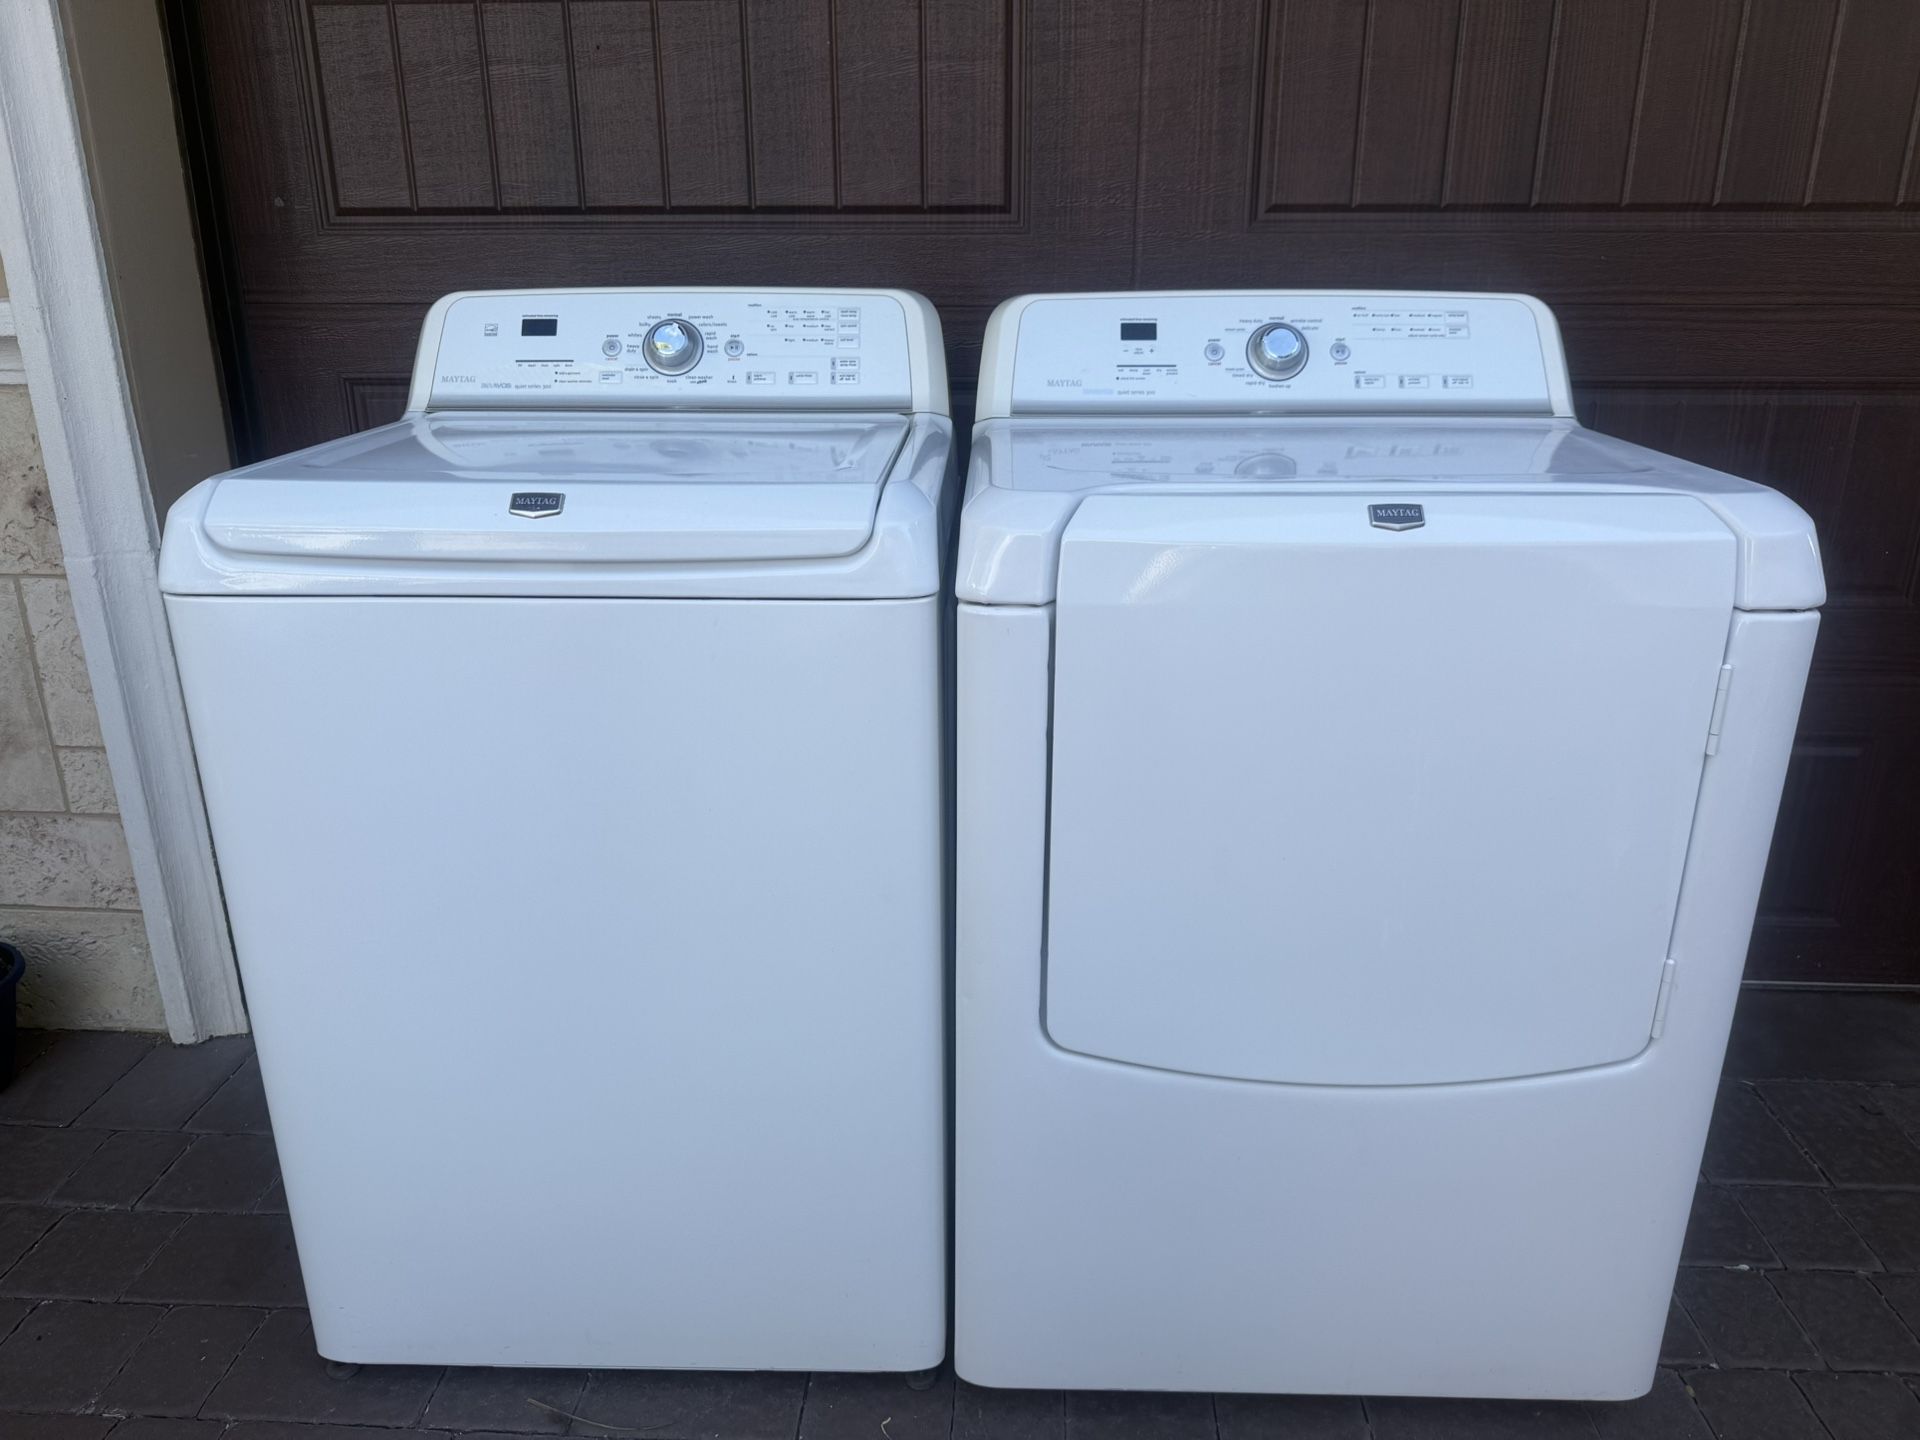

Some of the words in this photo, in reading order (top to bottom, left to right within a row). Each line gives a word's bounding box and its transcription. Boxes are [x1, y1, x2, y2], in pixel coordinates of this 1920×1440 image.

[441, 375, 476, 383] MAYTAG
[1046, 379, 1082, 387] MAYTAG
[515, 497, 557, 505] MAYTAG
[1376, 508, 1419, 517] MAYTAG
